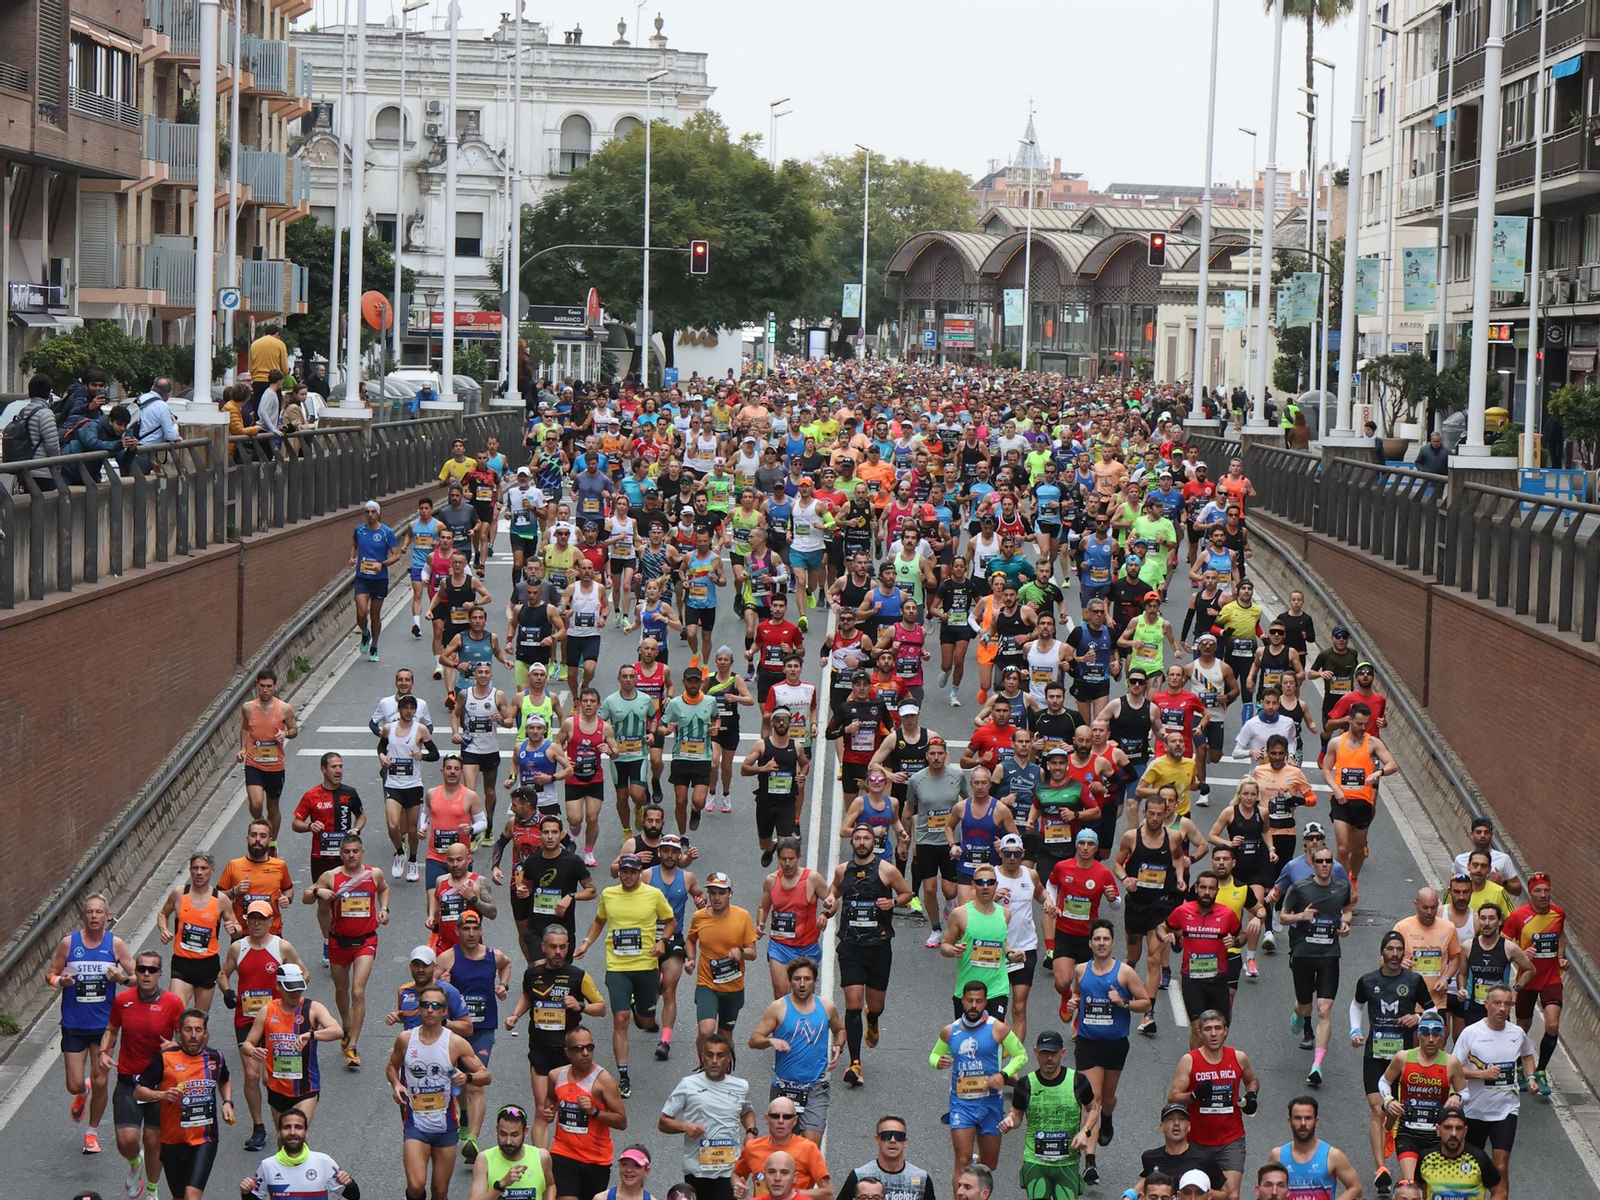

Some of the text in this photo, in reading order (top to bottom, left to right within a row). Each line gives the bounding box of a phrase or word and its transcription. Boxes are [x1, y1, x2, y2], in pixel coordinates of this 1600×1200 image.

[925, 331, 933, 341] P
[77, 964, 103, 973] STEVE
[1195, 1070, 1236, 1080] COSTA RICA
